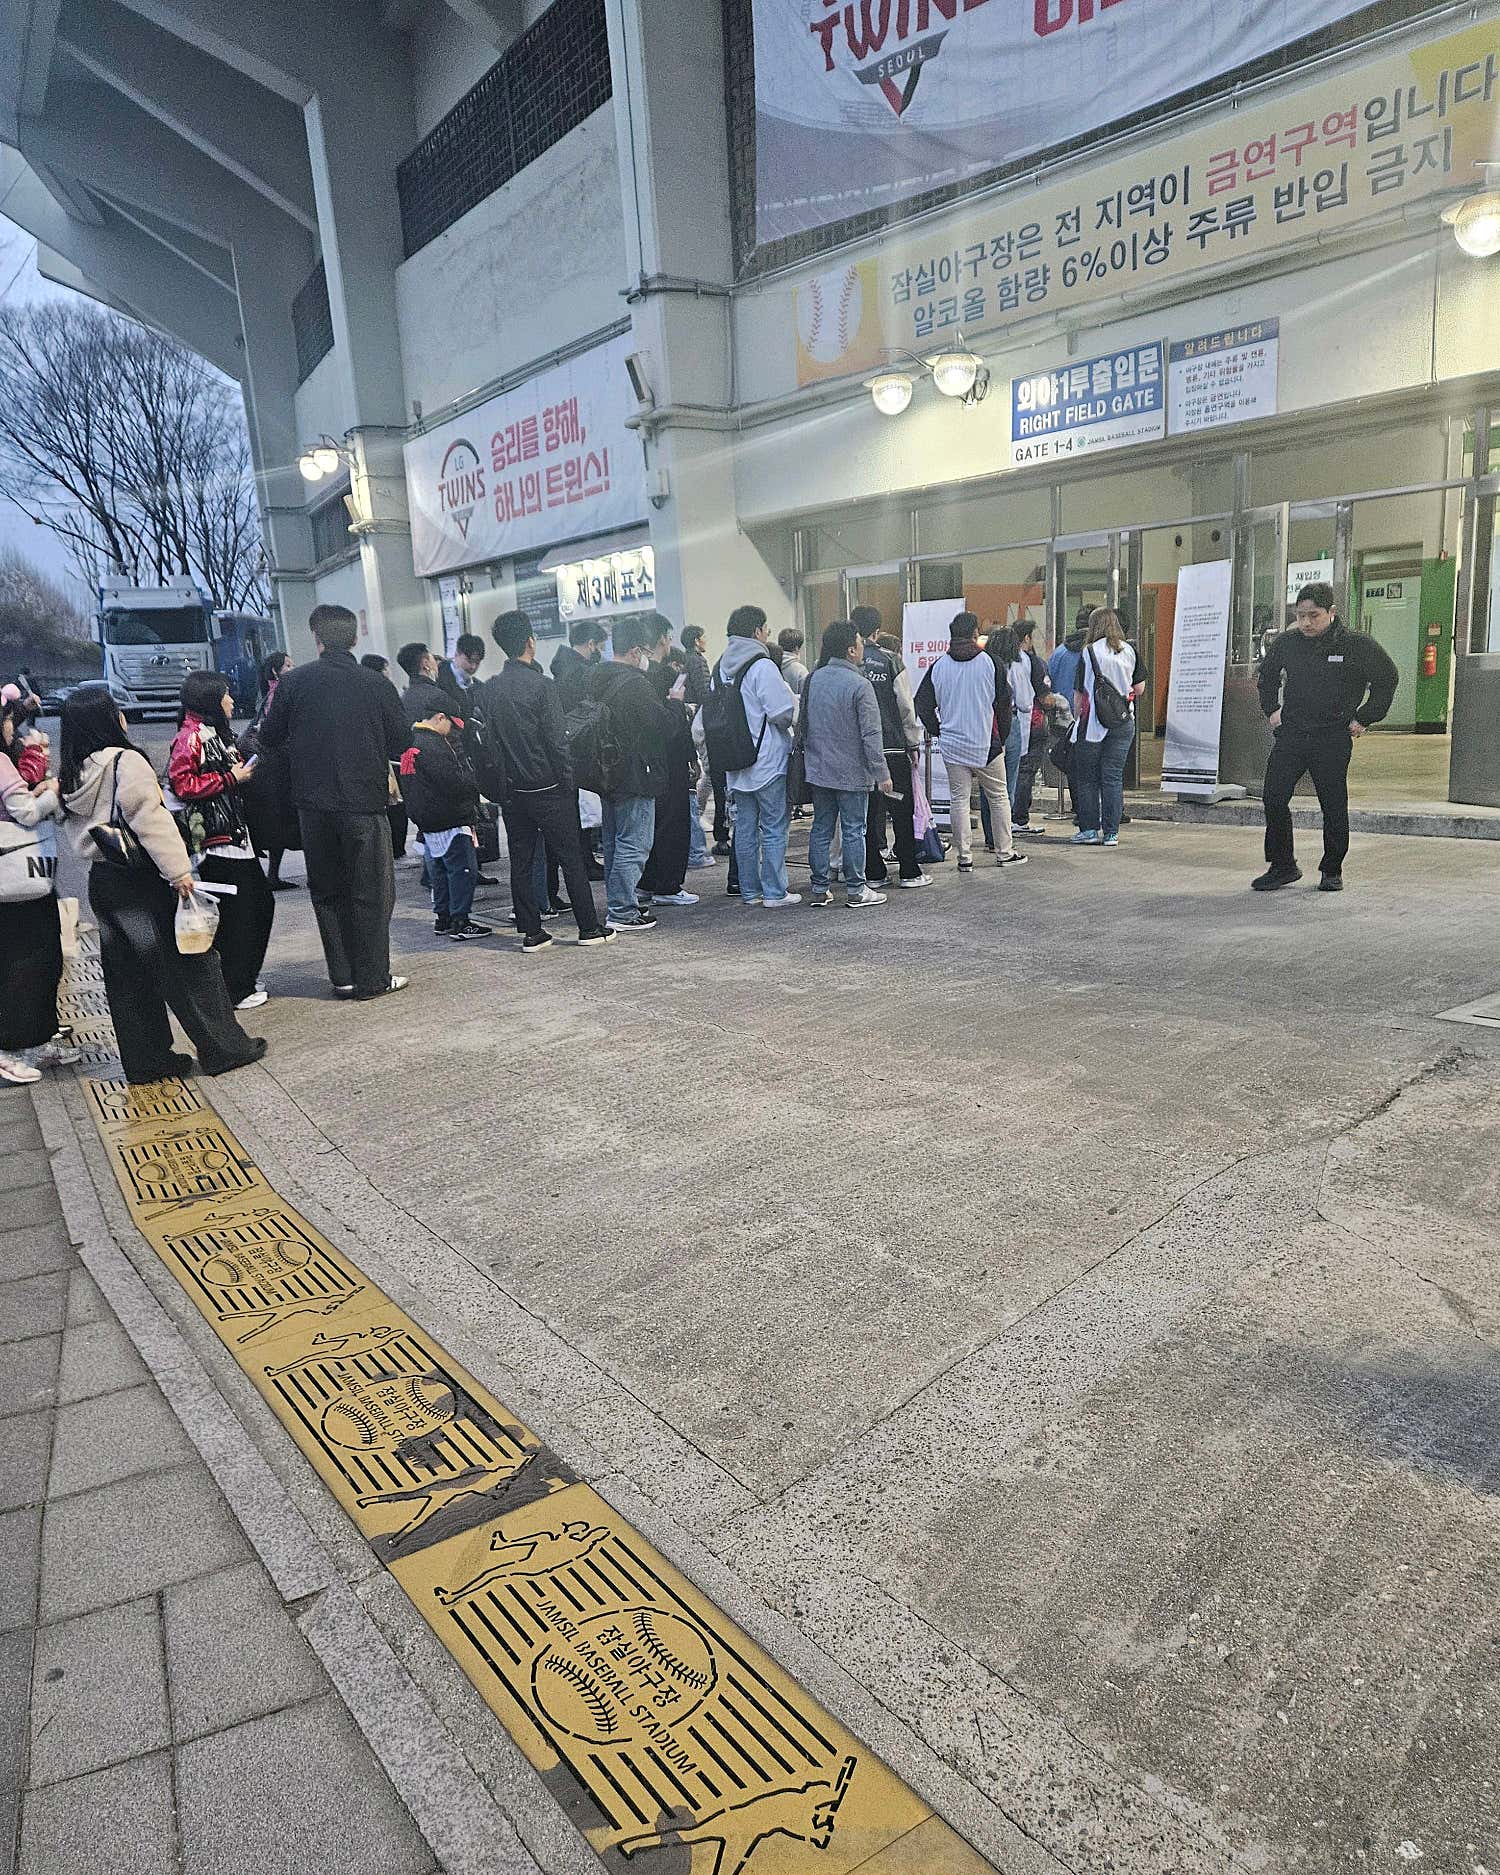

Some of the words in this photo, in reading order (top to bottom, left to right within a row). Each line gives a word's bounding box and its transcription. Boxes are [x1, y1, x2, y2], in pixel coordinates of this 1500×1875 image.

[878, 49, 925, 79] SEOUL
[891, 222, 1043, 304] 잠실야구장은
[1055, 205, 1081, 248] 전
[1094, 165, 1190, 230] 지역이
[1206, 53, 1498, 197] 금연구역입니다
[913, 287, 985, 338] 알코올
[997, 263, 1051, 312] 함량
[1062, 220, 1173, 288] 6%이상
[1186, 194, 1257, 249] 주류
[1274, 161, 1349, 224] 반입
[1366, 126, 1453, 196] 금지
[1184, 325, 1263, 356] 알려드립니다
[1017, 346, 1159, 412] 외야1루출입문
[491, 414, 540, 473] 승리를
[542, 396, 586, 452] 향해,
[1019, 410, 1061, 436] RIGHT
[1065, 402, 1106, 425] FIELD
[1111, 388, 1154, 413] GATE
[454, 455, 465, 472] LG
[1015, 441, 1049, 462] GATE
[1054, 437, 1073, 455] 1-4
[1107, 428, 1136, 441] BASEBALL
[1137, 424, 1161, 435] STADIUM
[438, 467, 486, 512] TWINS
[493, 470, 542, 523] 하나의
[545, 447, 610, 508] 트윈스!
[577, 565, 654, 608] 제3매표소
[1295, 570, 1321, 581] 재입장
[927, 640, 950, 652] 외야
[338, 1372, 365, 1397] JAMSIL
[358, 1395, 394, 1430] BASEBALL
[376, 1386, 427, 1431] 잠실야구장
[536, 1600, 580, 1643] JAMSIL
[573, 1639, 634, 1706] BASEBALL
[629, 1703, 698, 1775] STADIUM
[596, 1624, 682, 1708] 잠실야구장
